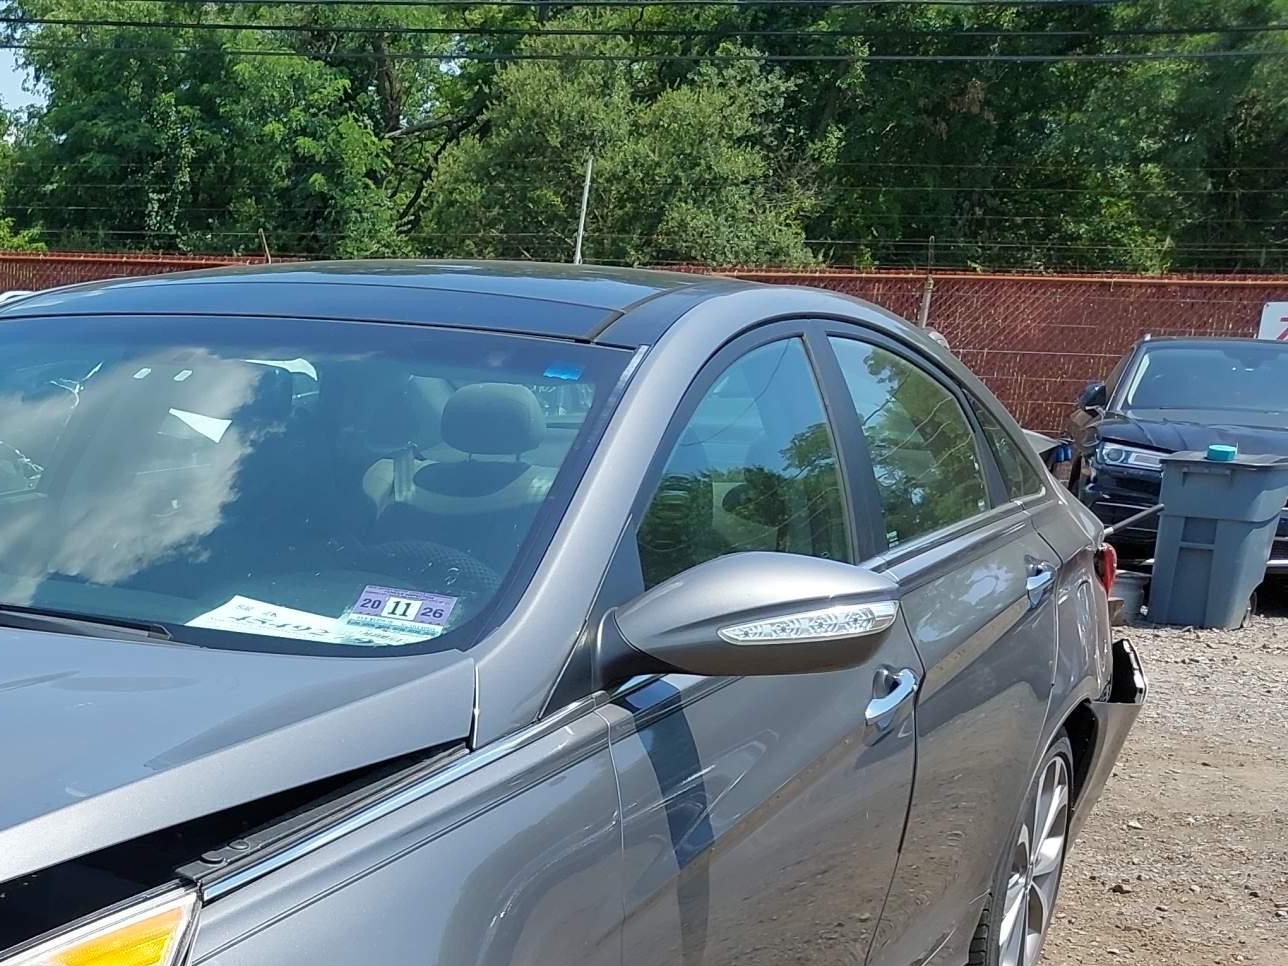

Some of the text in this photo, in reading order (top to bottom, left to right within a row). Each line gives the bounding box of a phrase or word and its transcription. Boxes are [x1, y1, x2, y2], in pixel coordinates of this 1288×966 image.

[360, 598, 445, 619] 20 11 26
